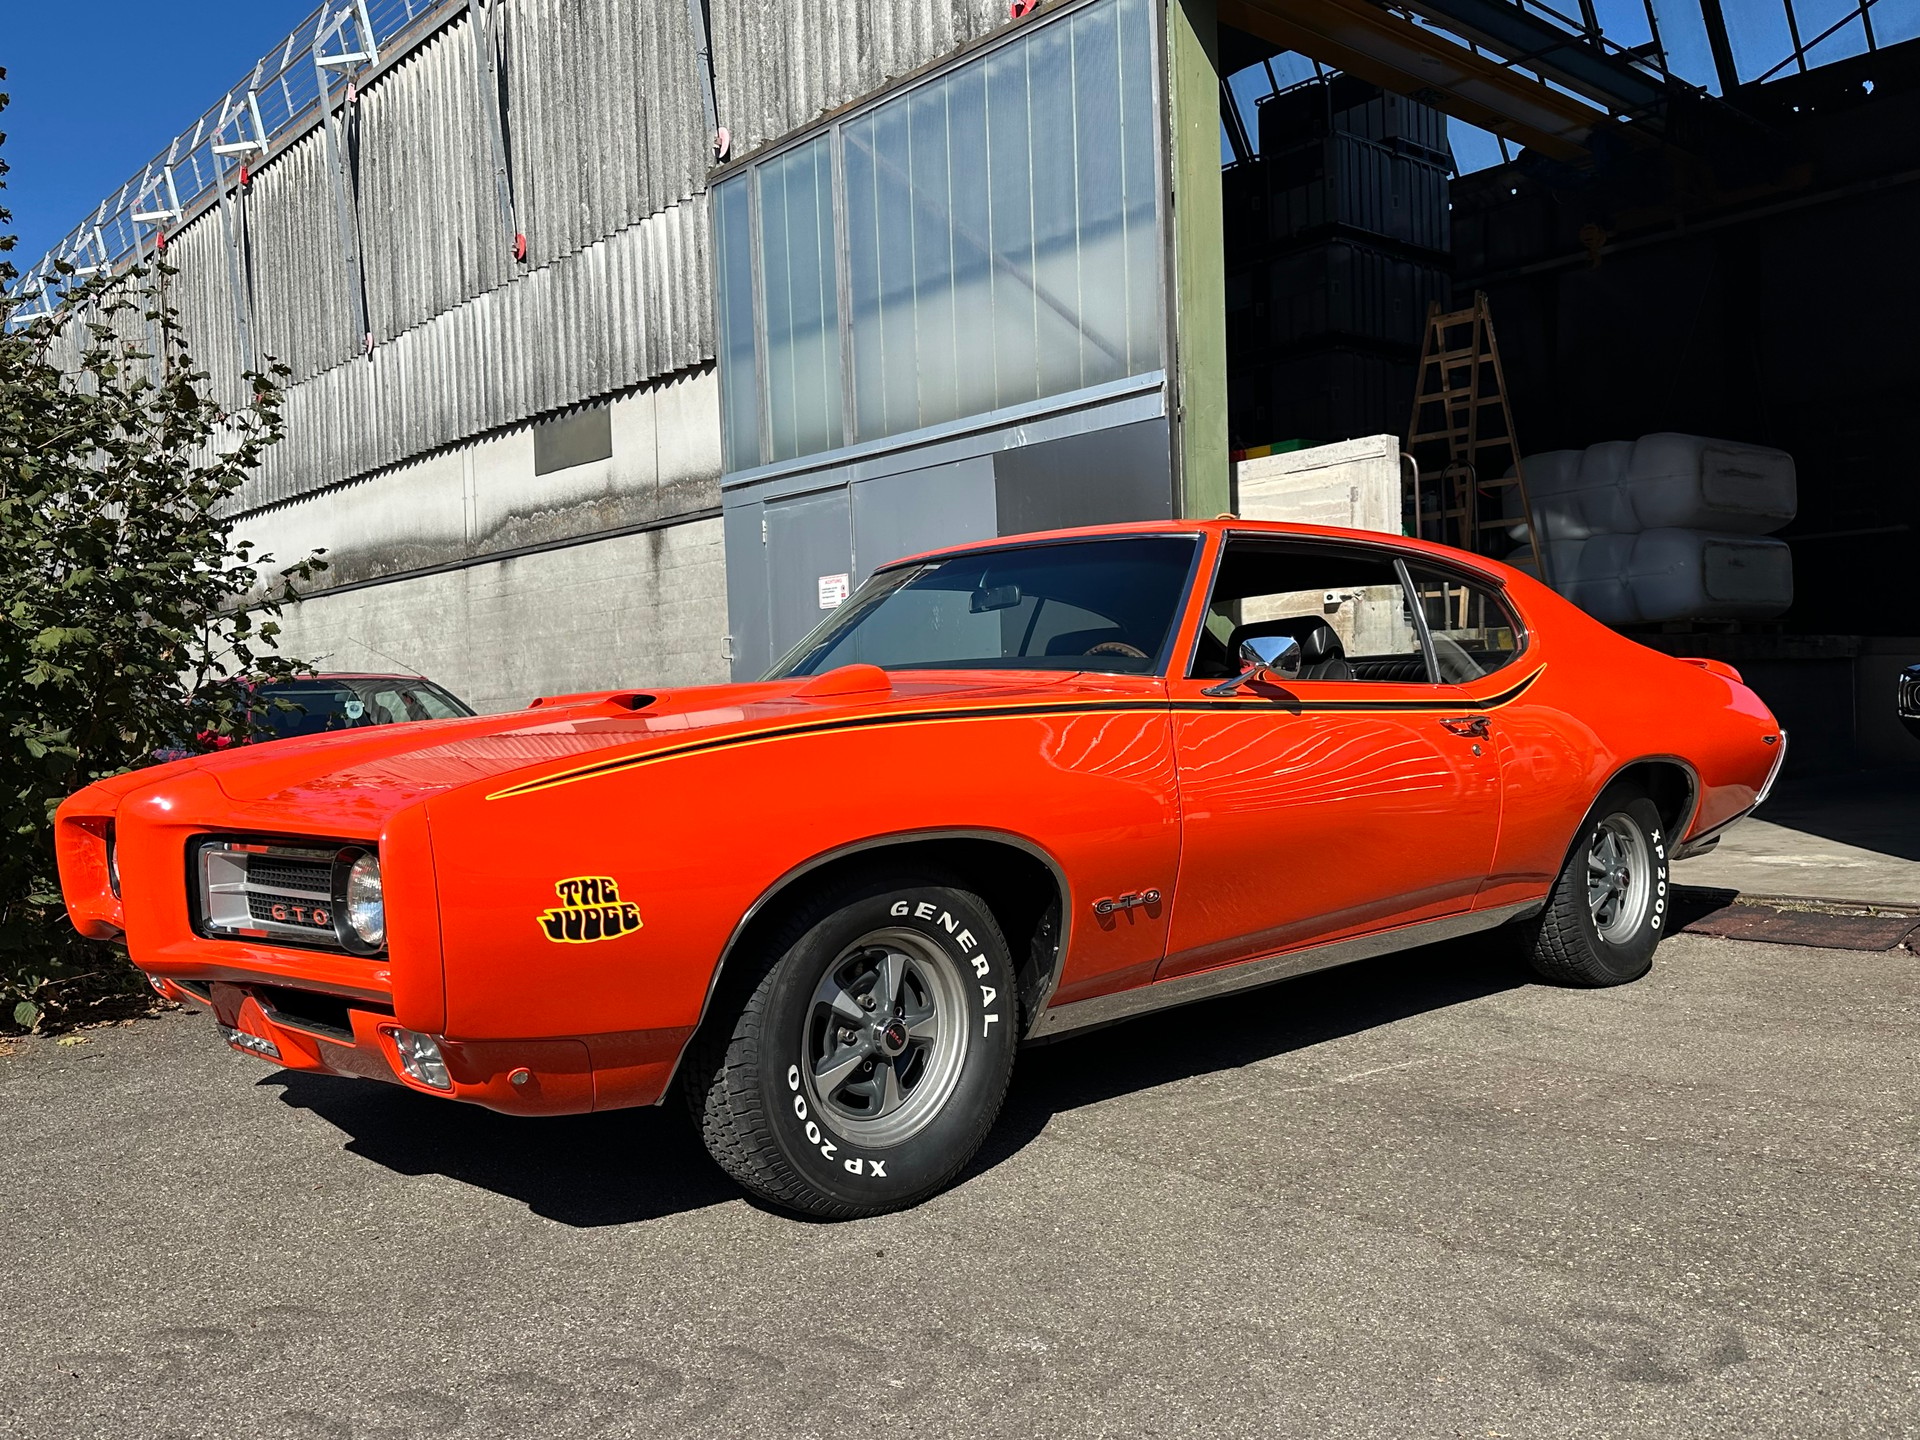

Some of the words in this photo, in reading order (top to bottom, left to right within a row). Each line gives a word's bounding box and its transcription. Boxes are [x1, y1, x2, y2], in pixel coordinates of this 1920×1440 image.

[1651, 829, 1664, 860] XP
[557, 877, 619, 907] THE
[1094, 890, 1160, 914] GTO
[1651, 867, 1666, 929] 2000
[271, 904, 329, 925] GTO
[539, 903, 642, 942] JUDGE
[890, 900, 999, 1038] GENERAL
[787, 1064, 838, 1161] 2000
[844, 1158, 888, 1178] XP
